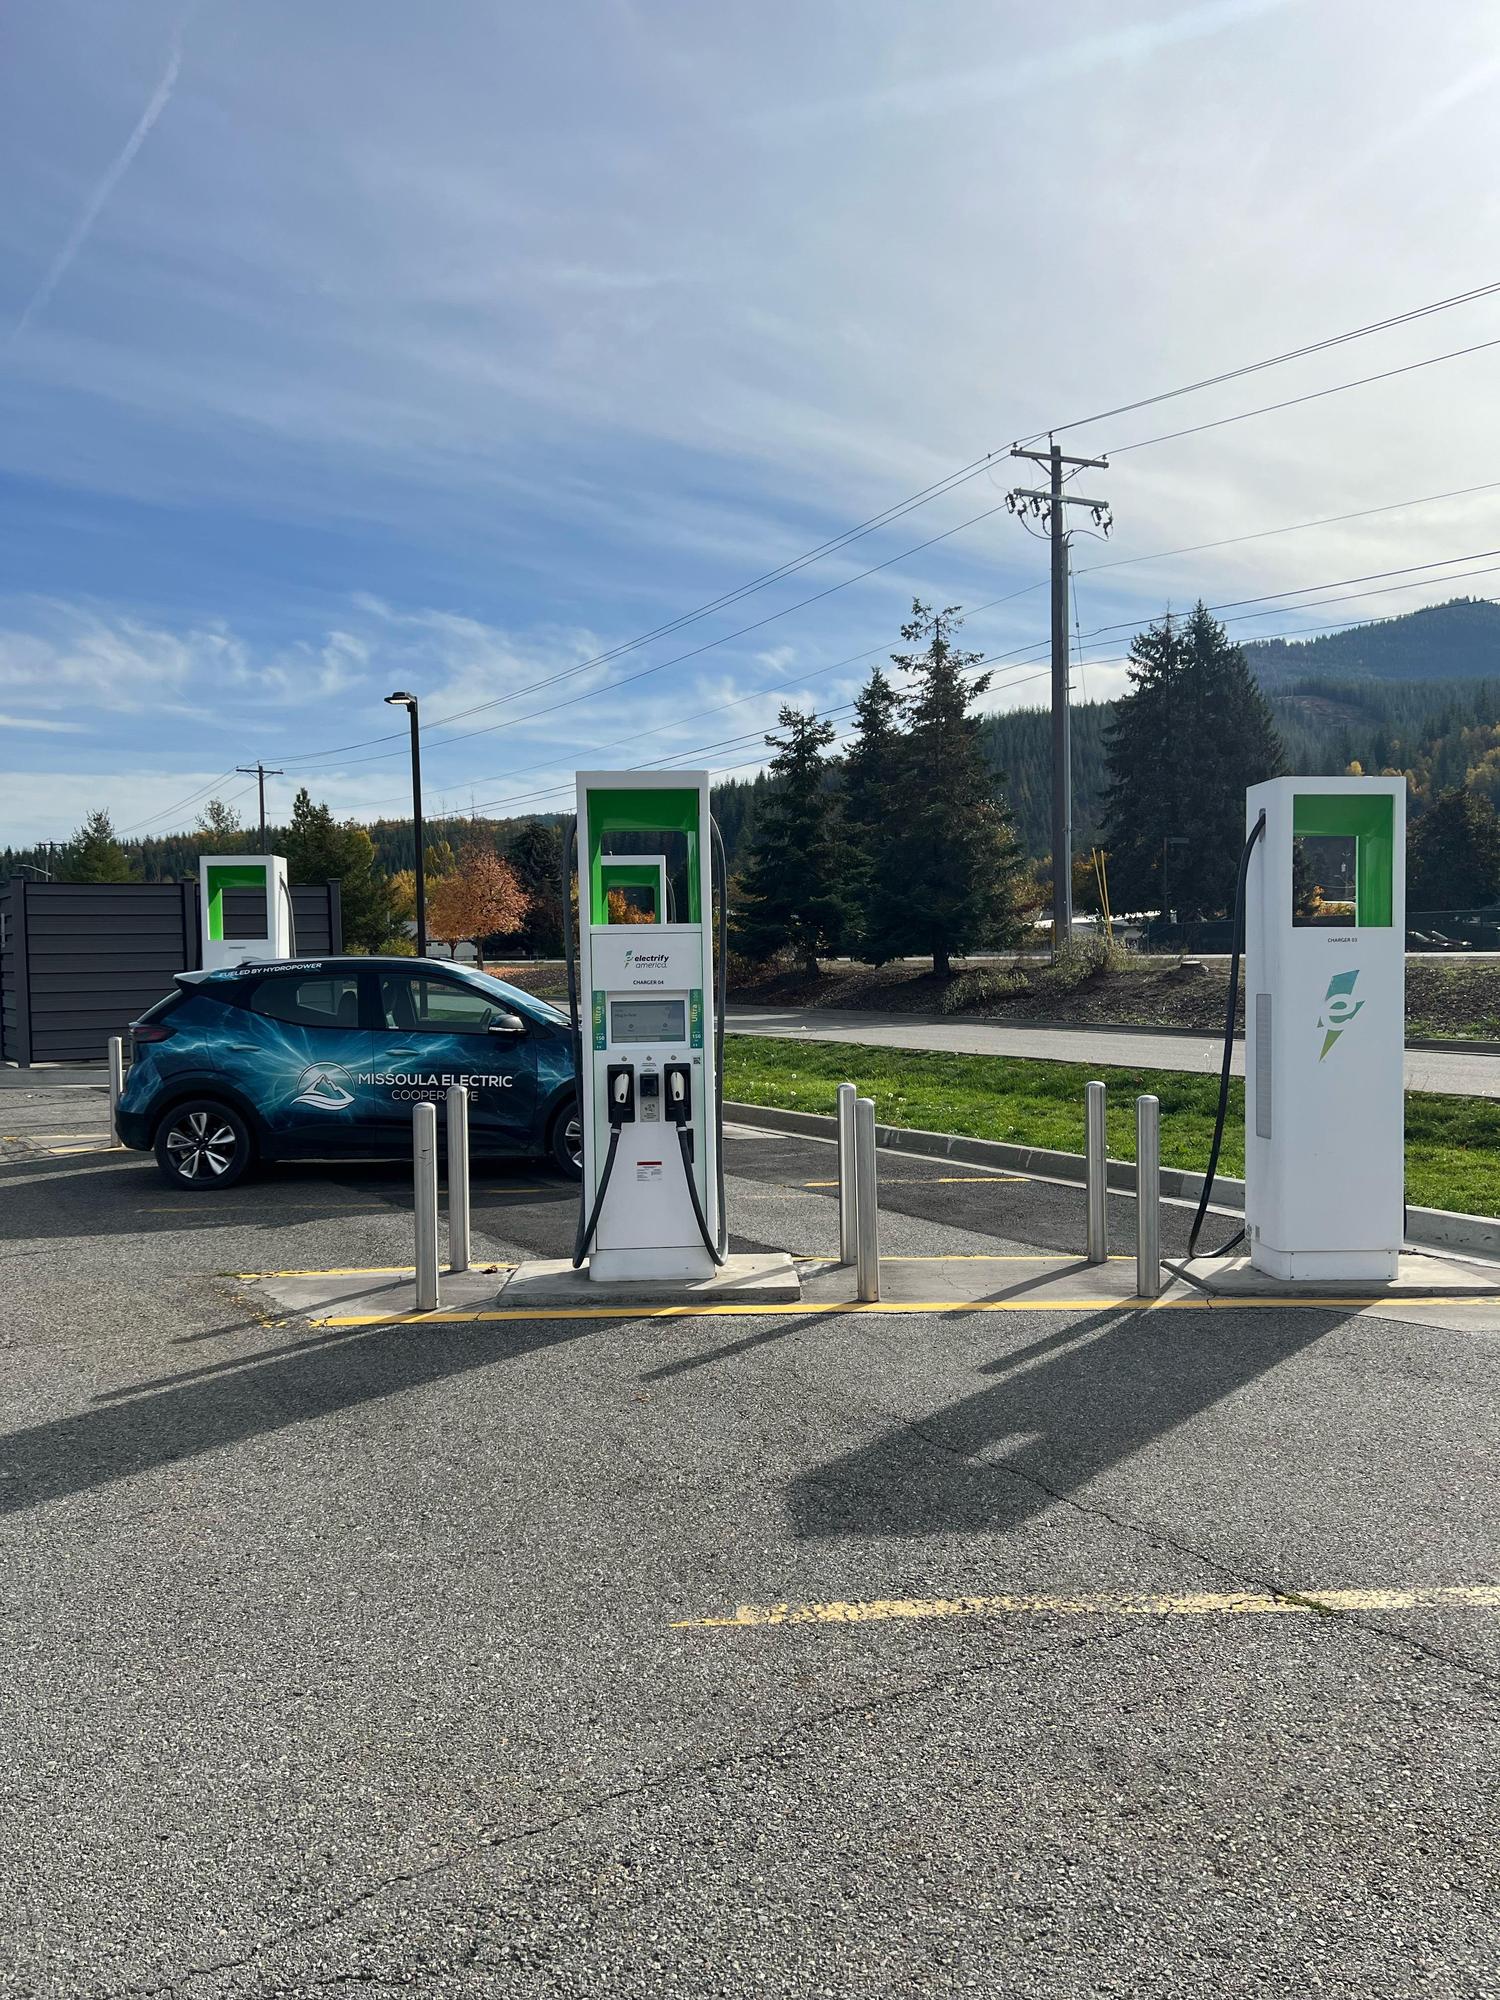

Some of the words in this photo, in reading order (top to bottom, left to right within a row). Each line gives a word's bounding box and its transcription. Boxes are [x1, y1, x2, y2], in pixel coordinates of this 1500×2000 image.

[634, 954, 670, 963] electrify
[220, 969, 250, 978] FUELED
[263, 962, 322, 974] HYDROPOWER
[594, 1006, 602, 1024] Ultra
[358, 1073, 438, 1086] MISSOULA
[441, 1074, 513, 1088] ELECTRIC
